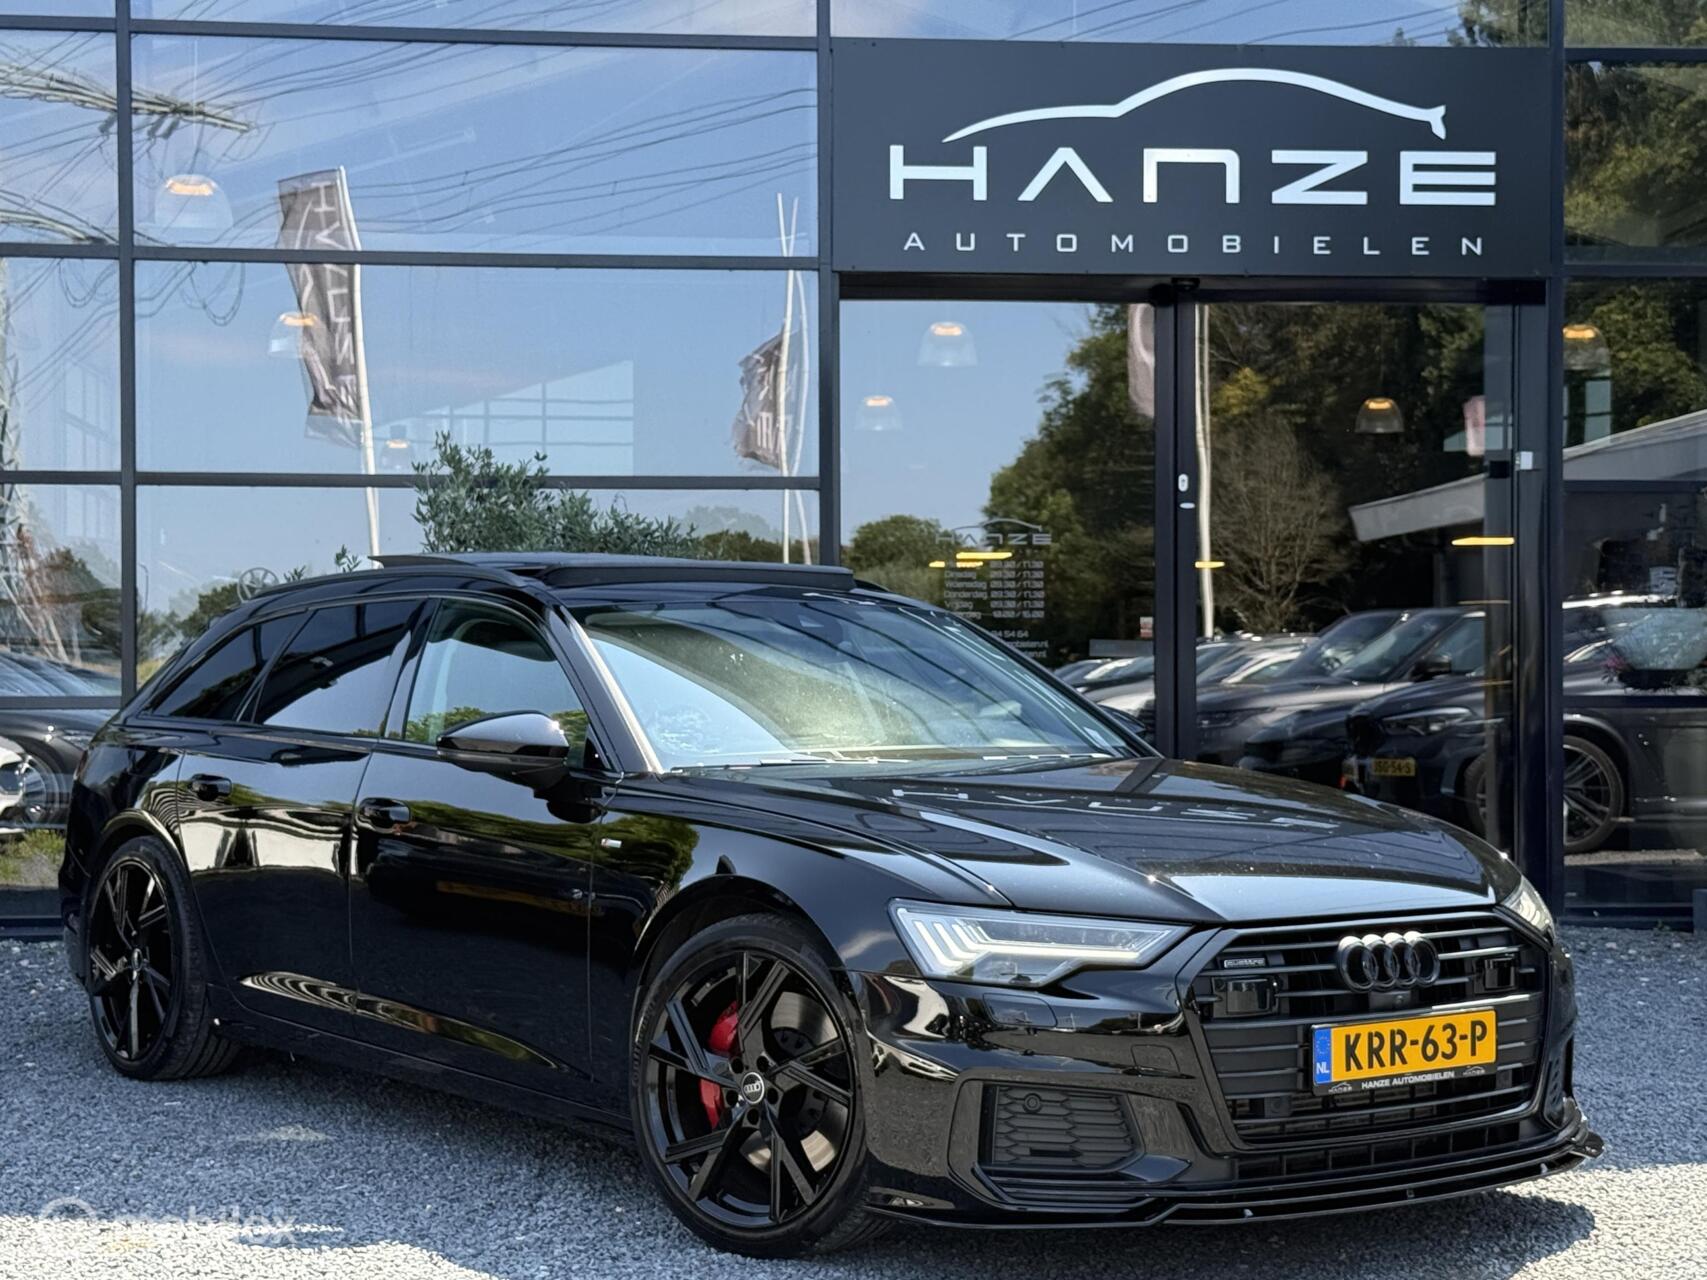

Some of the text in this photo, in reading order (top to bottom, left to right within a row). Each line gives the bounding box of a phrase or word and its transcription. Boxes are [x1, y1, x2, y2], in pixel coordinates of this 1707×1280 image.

[889, 144, 1497, 206] HANZE
[903, 231, 1483, 257] AUTOMOBIELEN
[1344, 1019, 1488, 1073] KRR-63-P
[1316, 1062, 1330, 1076] NL
[1361, 1070, 1456, 1090] HANZE AUTOMOBIELEN
